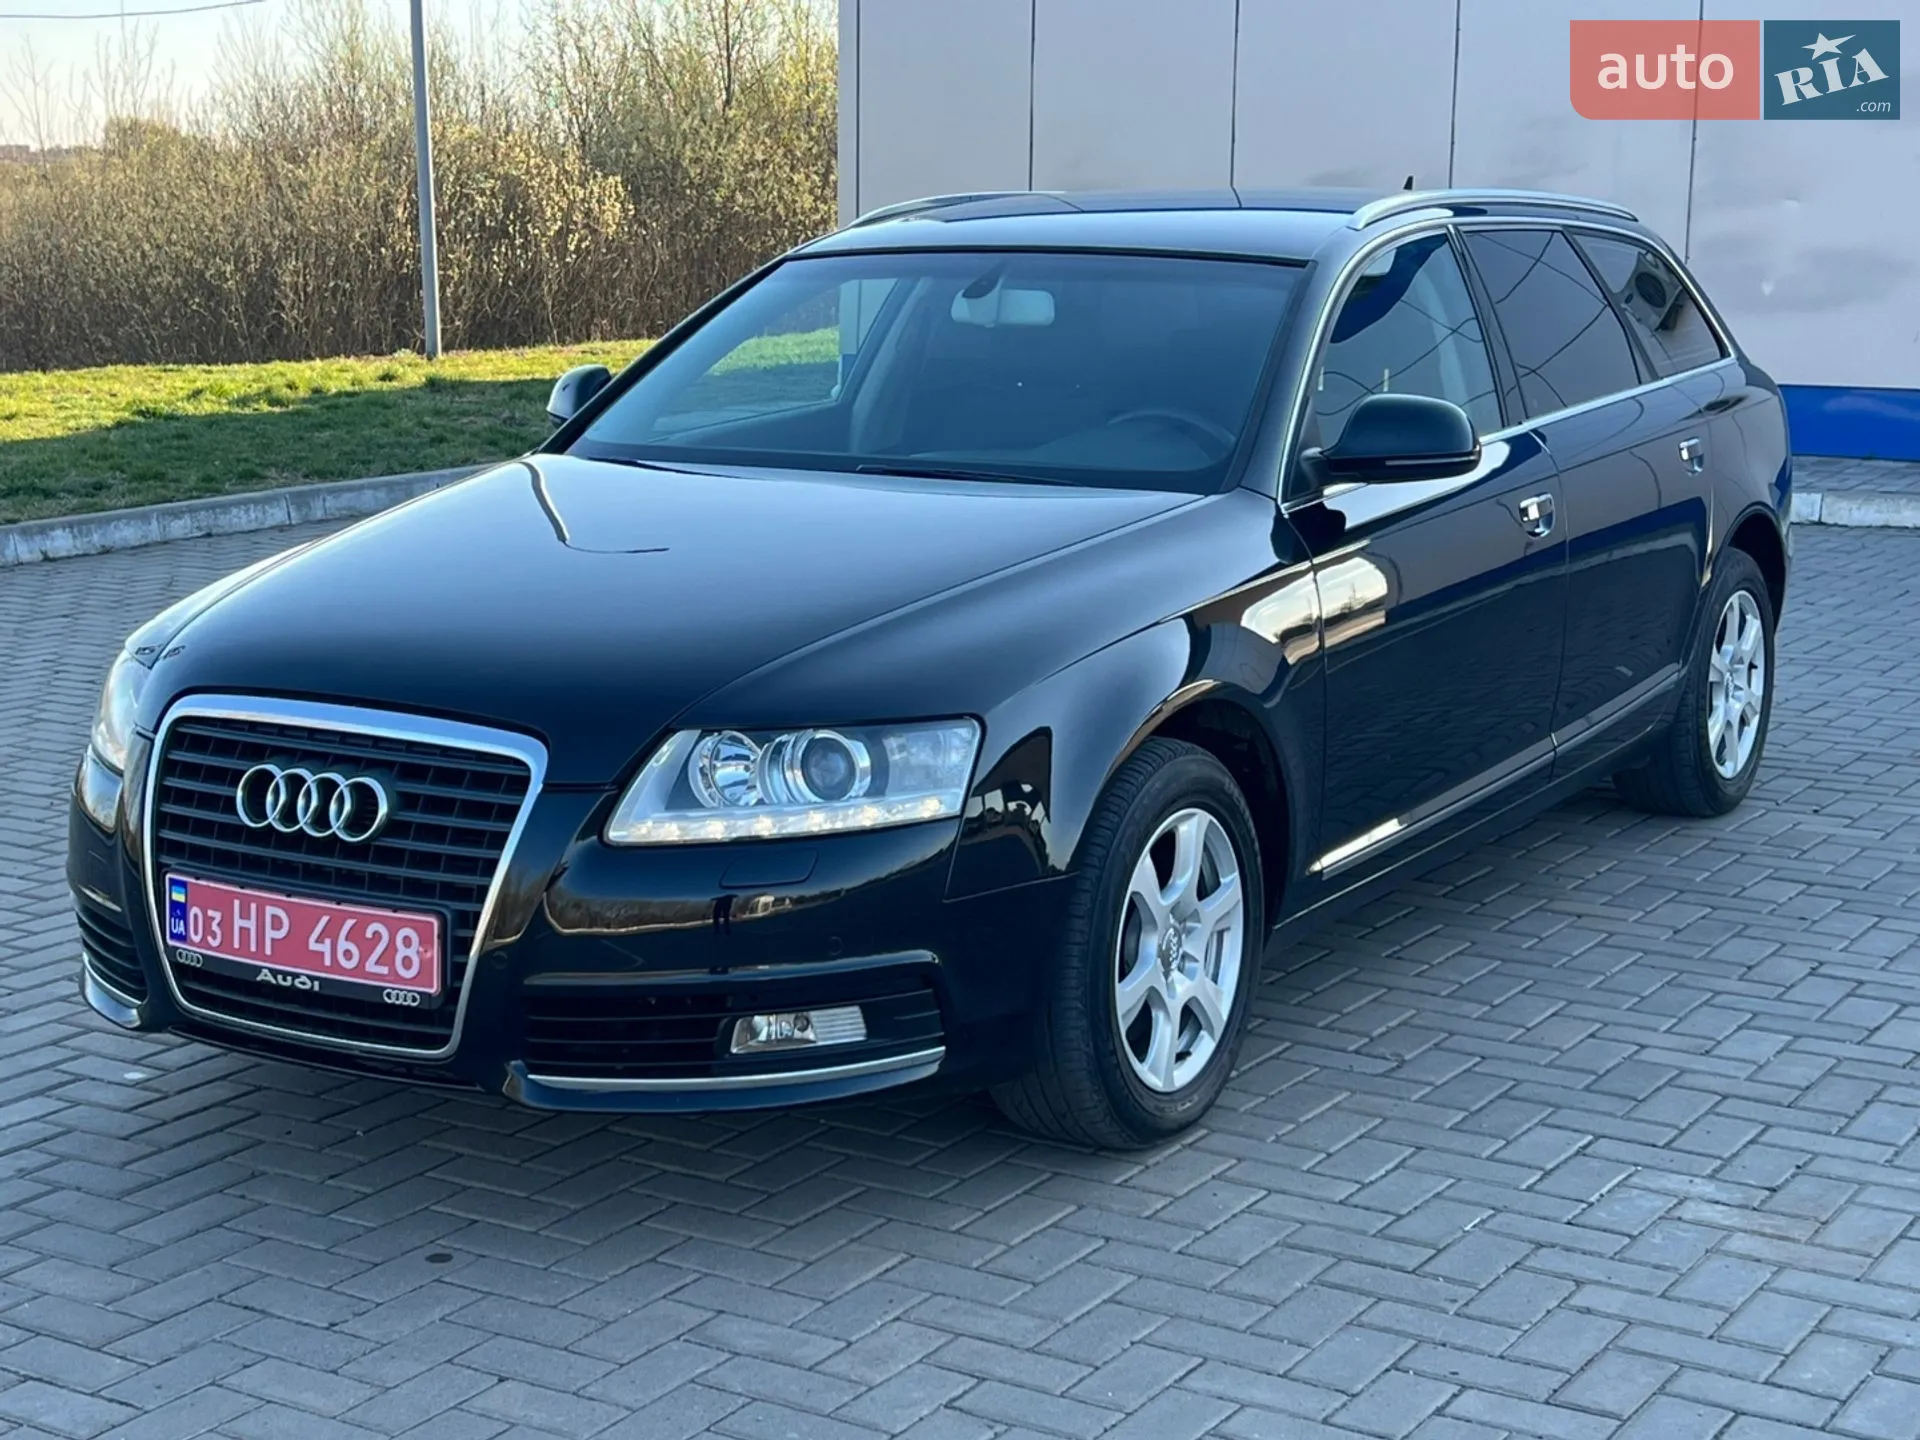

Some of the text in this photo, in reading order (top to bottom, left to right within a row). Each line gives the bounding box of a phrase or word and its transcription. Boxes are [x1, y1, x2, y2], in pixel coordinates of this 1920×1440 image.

[171, 917, 186, 936] UA
[189, 899, 421, 979] 03 HP 4628
